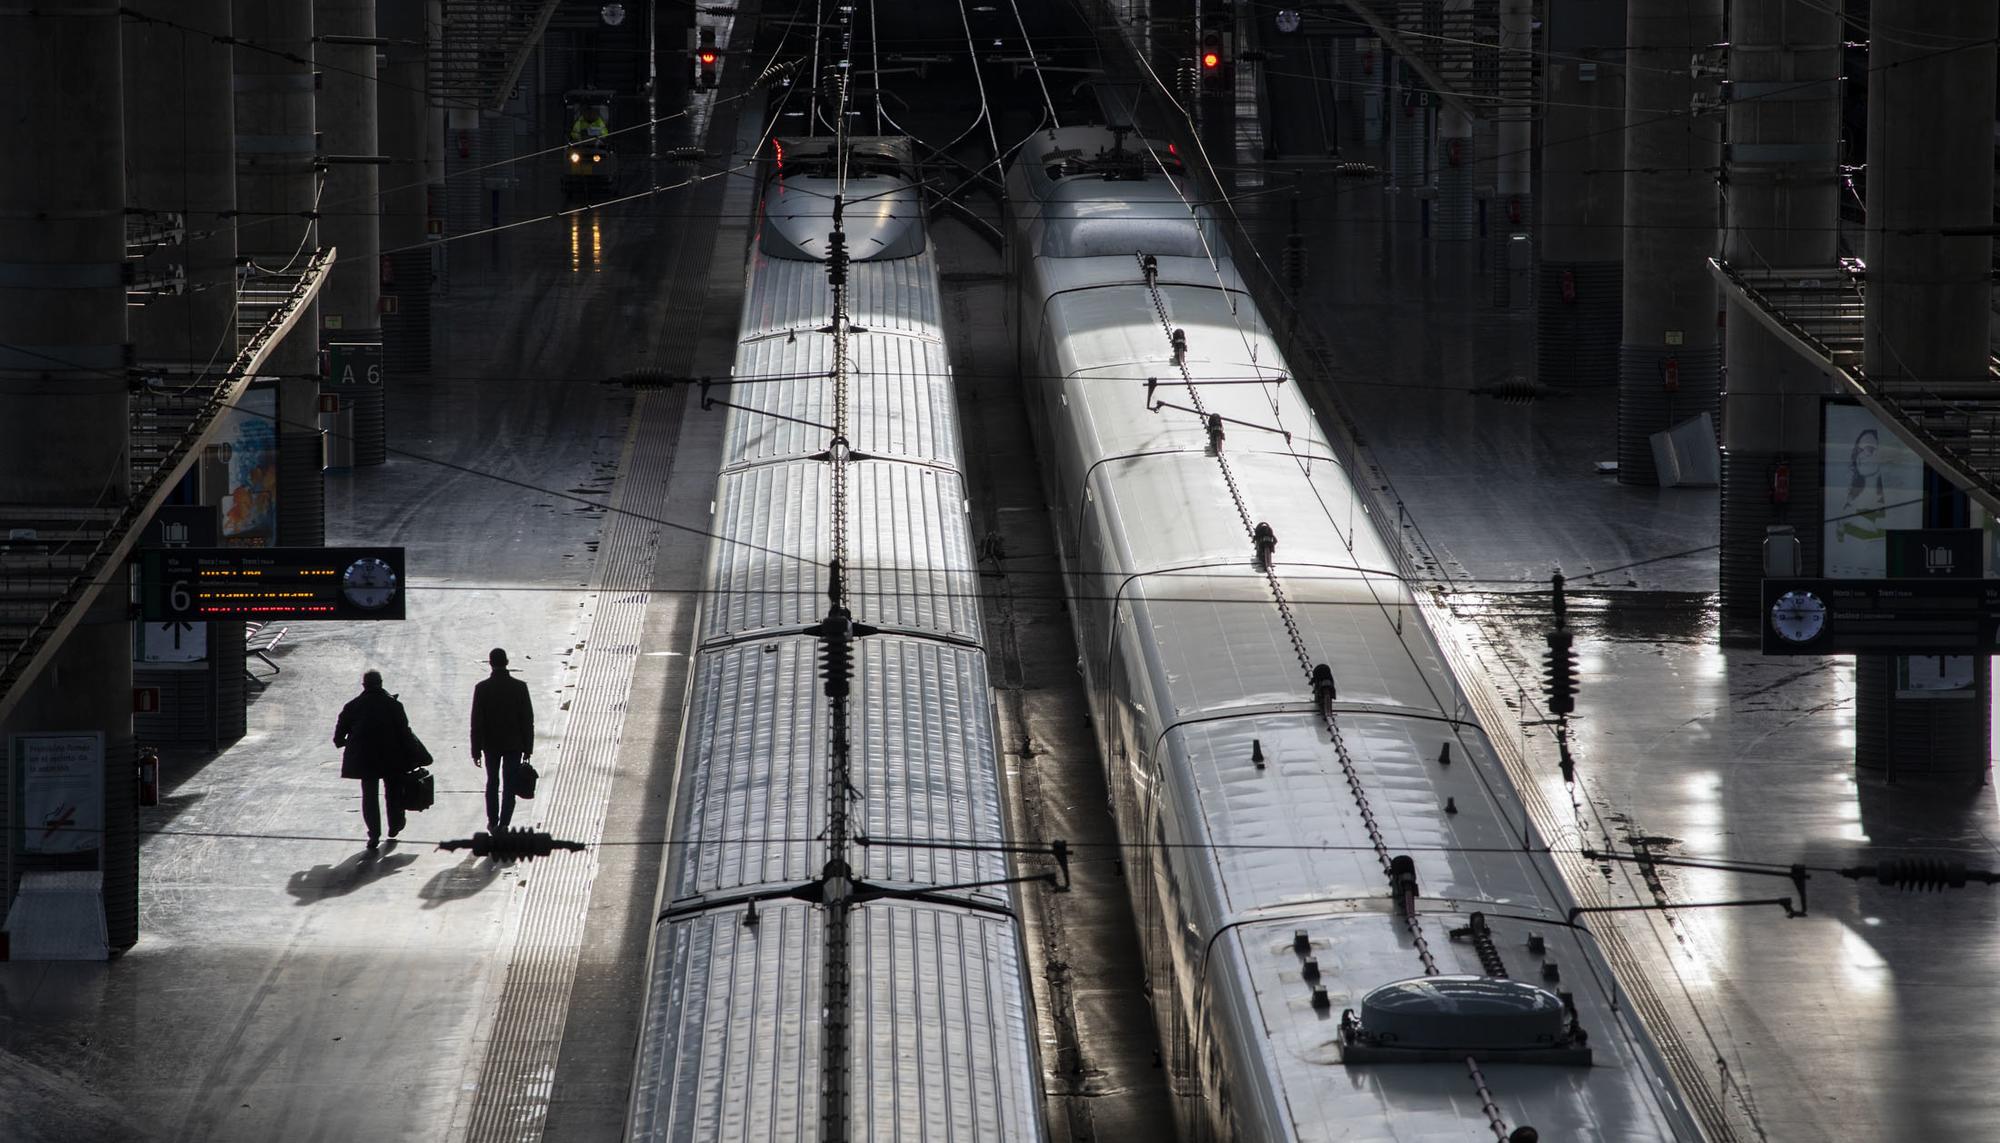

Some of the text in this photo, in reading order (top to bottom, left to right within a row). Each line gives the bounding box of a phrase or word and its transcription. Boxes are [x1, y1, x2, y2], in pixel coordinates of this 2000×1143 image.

[1420, 92, 1429, 106] B
[341, 364, 380, 384] A 6
[170, 580, 191, 612] 6
